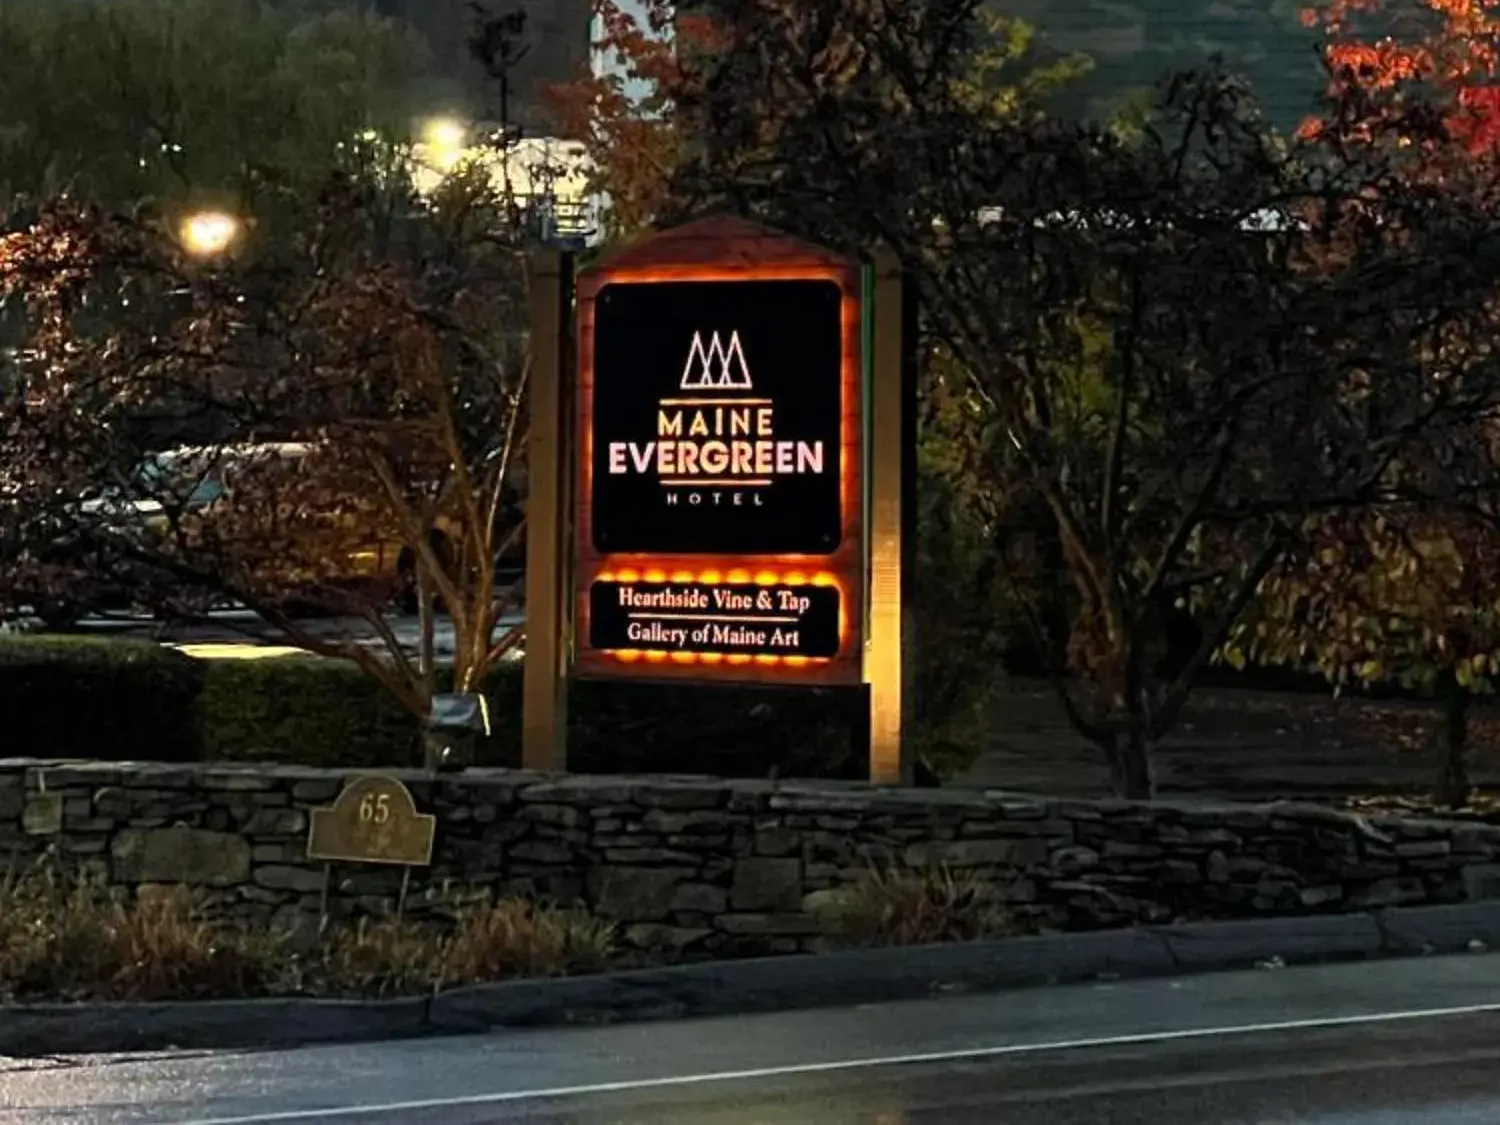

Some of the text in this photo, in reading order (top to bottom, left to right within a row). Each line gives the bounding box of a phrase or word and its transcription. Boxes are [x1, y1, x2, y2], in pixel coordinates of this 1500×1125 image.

[657, 407, 773, 437] MAINE
[608, 440, 824, 474] EVERGREEN
[667, 492, 763, 506] HOTEL
[619, 586, 810, 614] Hearthside Vine & Tap
[627, 623, 799, 647] Gallery of Maine Art
[359, 793, 390, 823] 65
